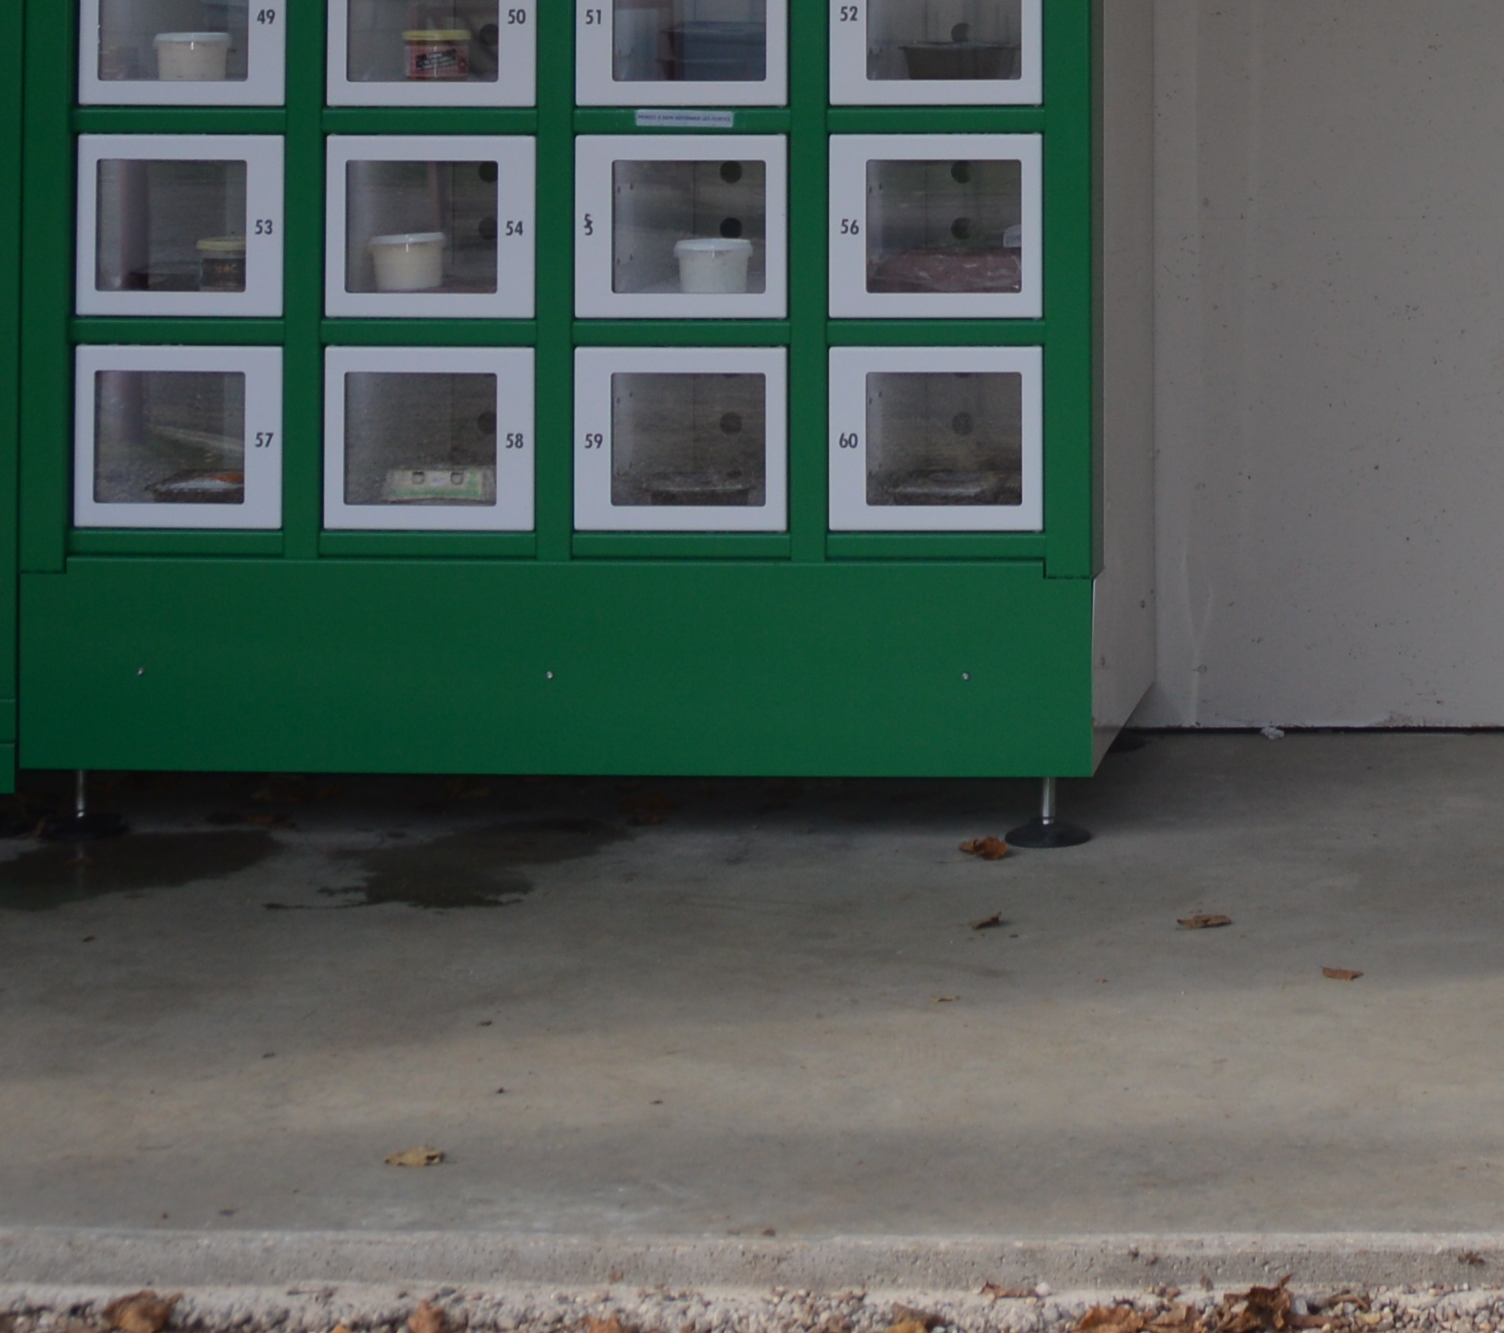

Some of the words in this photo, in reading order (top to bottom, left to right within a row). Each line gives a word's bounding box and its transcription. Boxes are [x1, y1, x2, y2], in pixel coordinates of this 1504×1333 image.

[256, 8, 276, 25] 49
[507, 8, 527, 25] 50
[585, 8, 602, 25] 51
[840, 5, 859, 22] 52
[255, 219, 273, 236] 53
[505, 220, 524, 237] 54
[840, 218, 860, 236] 56
[255, 431, 274, 448] 57
[505, 432, 524, 449] 58
[584, 433, 604, 449] 59
[838, 432, 859, 449] 60
